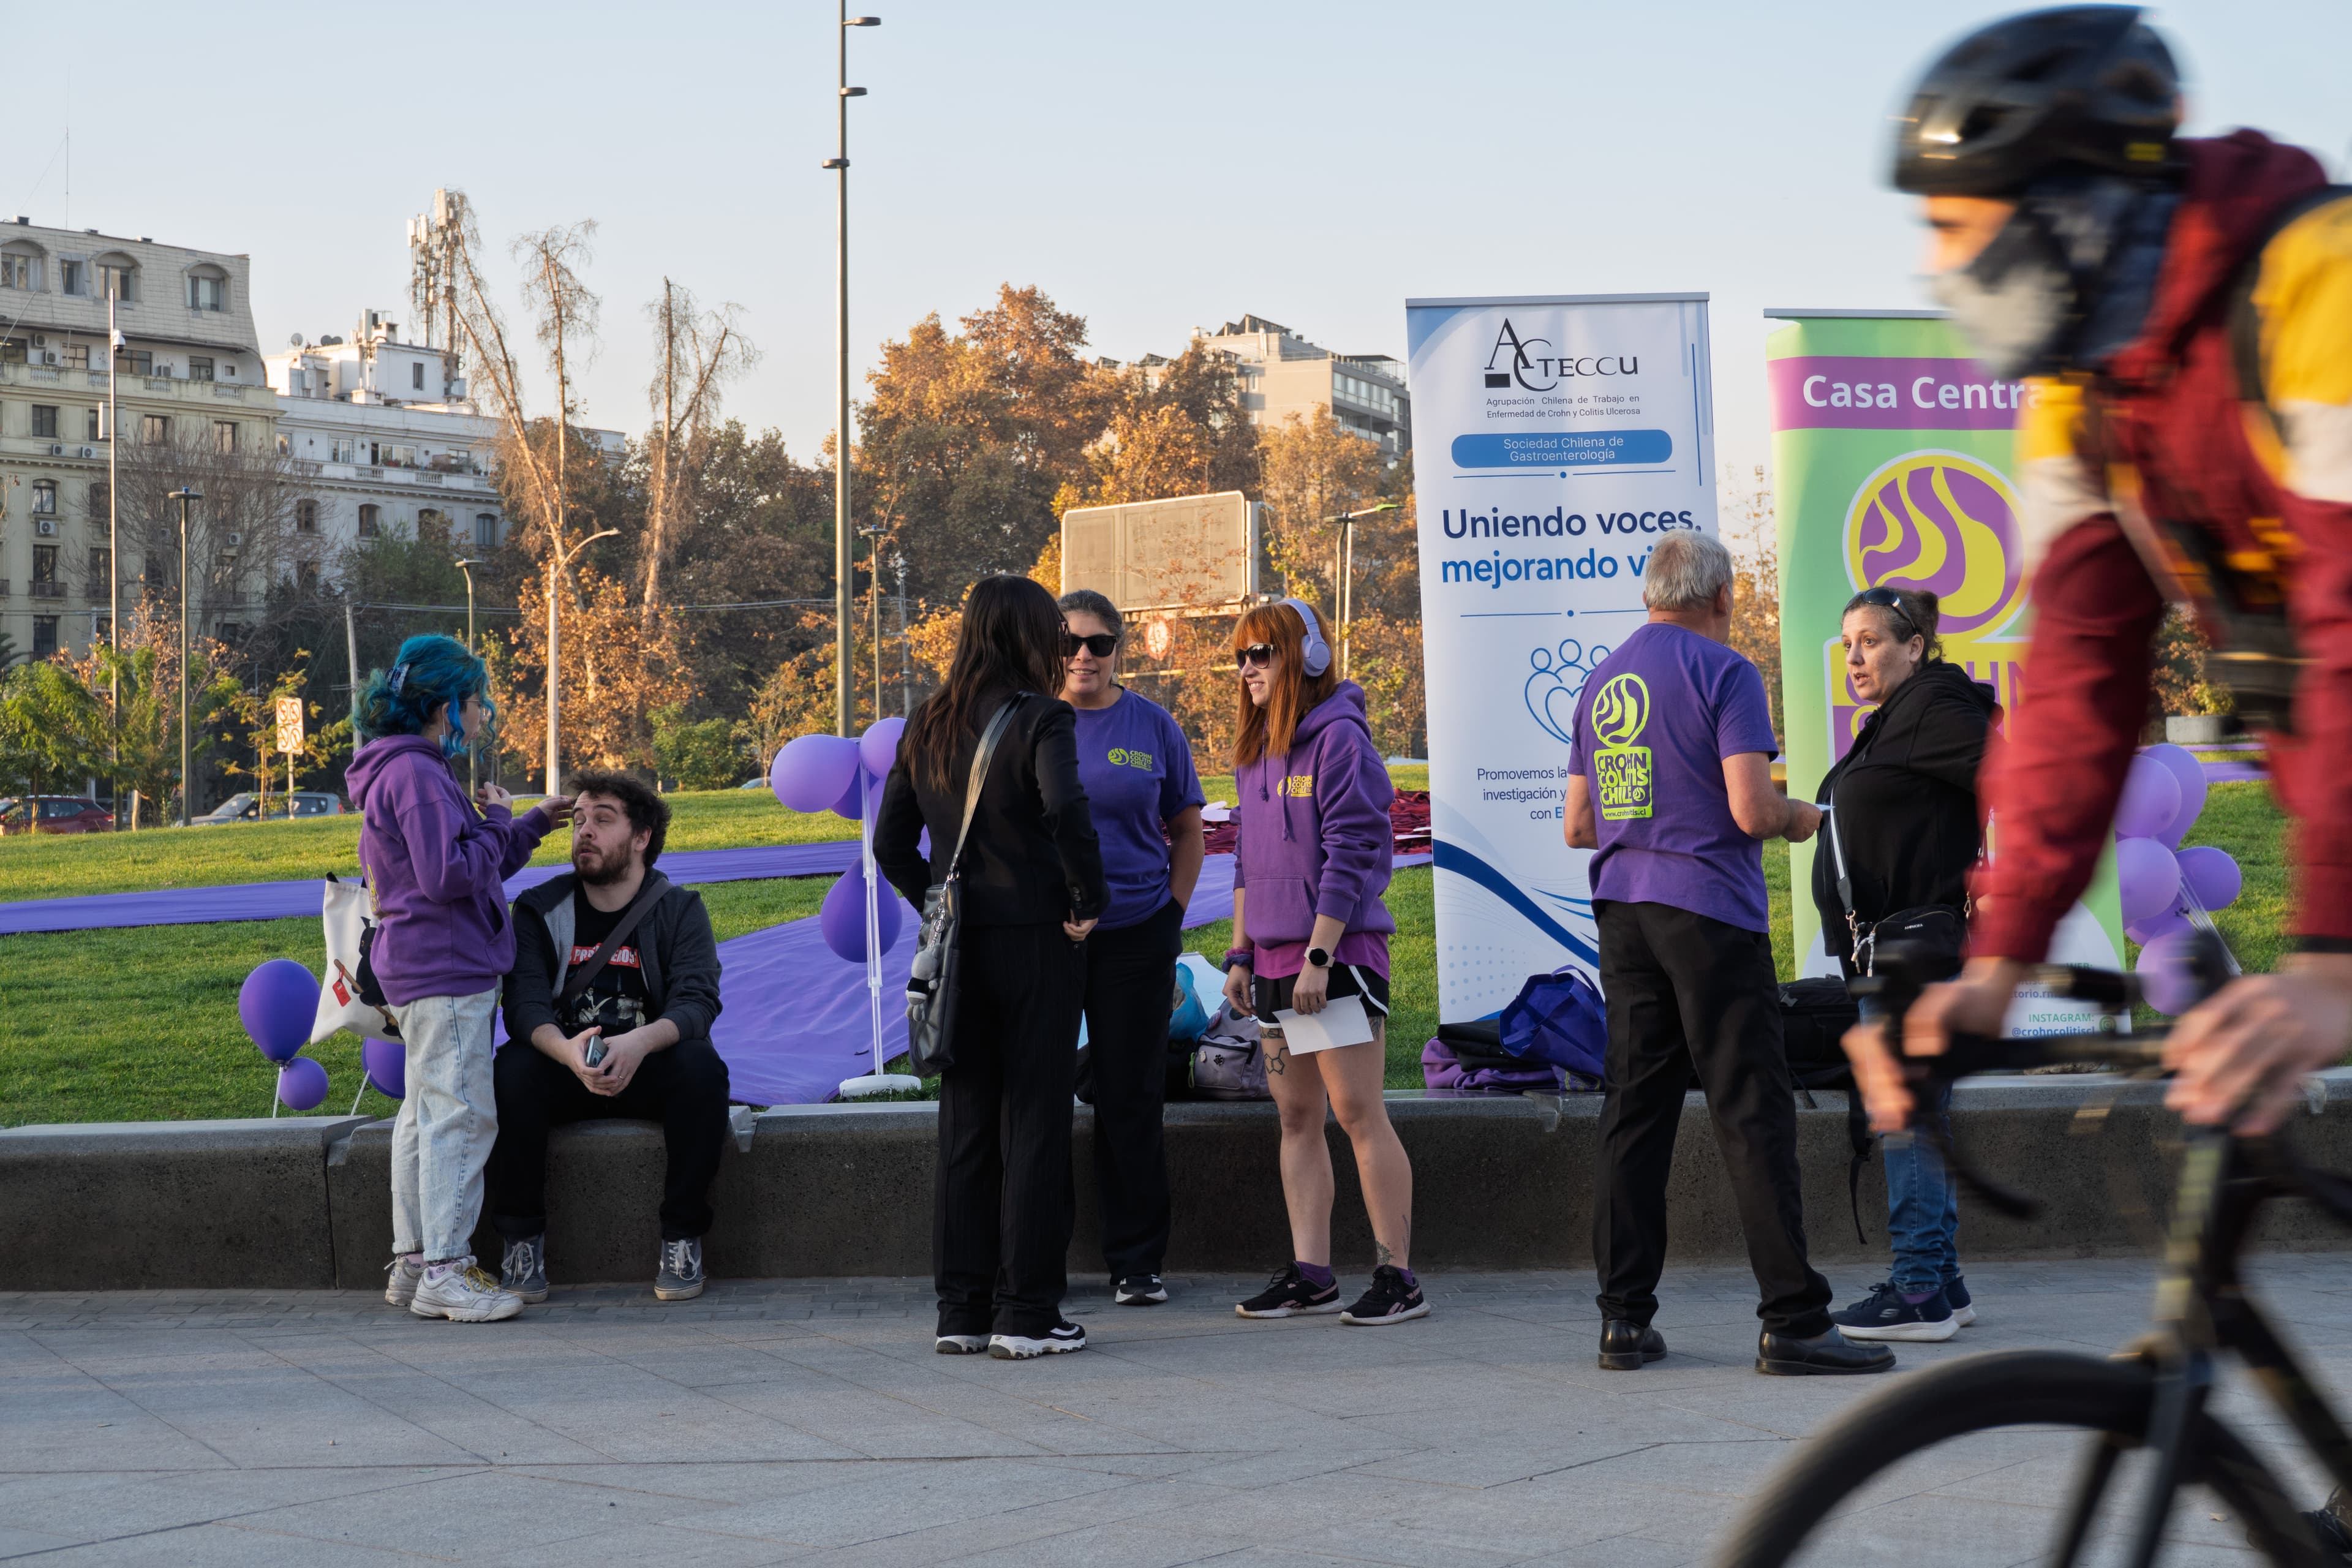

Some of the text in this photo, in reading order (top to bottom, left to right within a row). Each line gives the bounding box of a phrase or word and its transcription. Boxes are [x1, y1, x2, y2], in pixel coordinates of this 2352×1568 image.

[1802, 375, 1898, 409] Casa
[1486, 397, 1535, 407] Agrupación
[1592, 394, 1624, 404] Trabajo
[1487, 410, 1534, 418] Enfermedad
[1579, 407, 1604, 417] Colitis
[1504, 436, 1624, 449] Sociedad Chilena de
[1510, 448, 1615, 461] Gastroenterología
[1442, 506, 1586, 539] Uniendo
[1442, 548, 1618, 589] mejorando
[1129, 750, 1152, 760] CROHN
[1129, 755, 1152, 764] COLITIS
[1477, 768, 1554, 780] Promovemos
[1483, 787, 1567, 802] investigación y
[1601, 786, 1633, 805] CHILE
[1530, 810, 1551, 819] con
[2029, 1013, 2095, 1022] INSTAGRAM:
[459, 1283, 470, 1292] FILA
